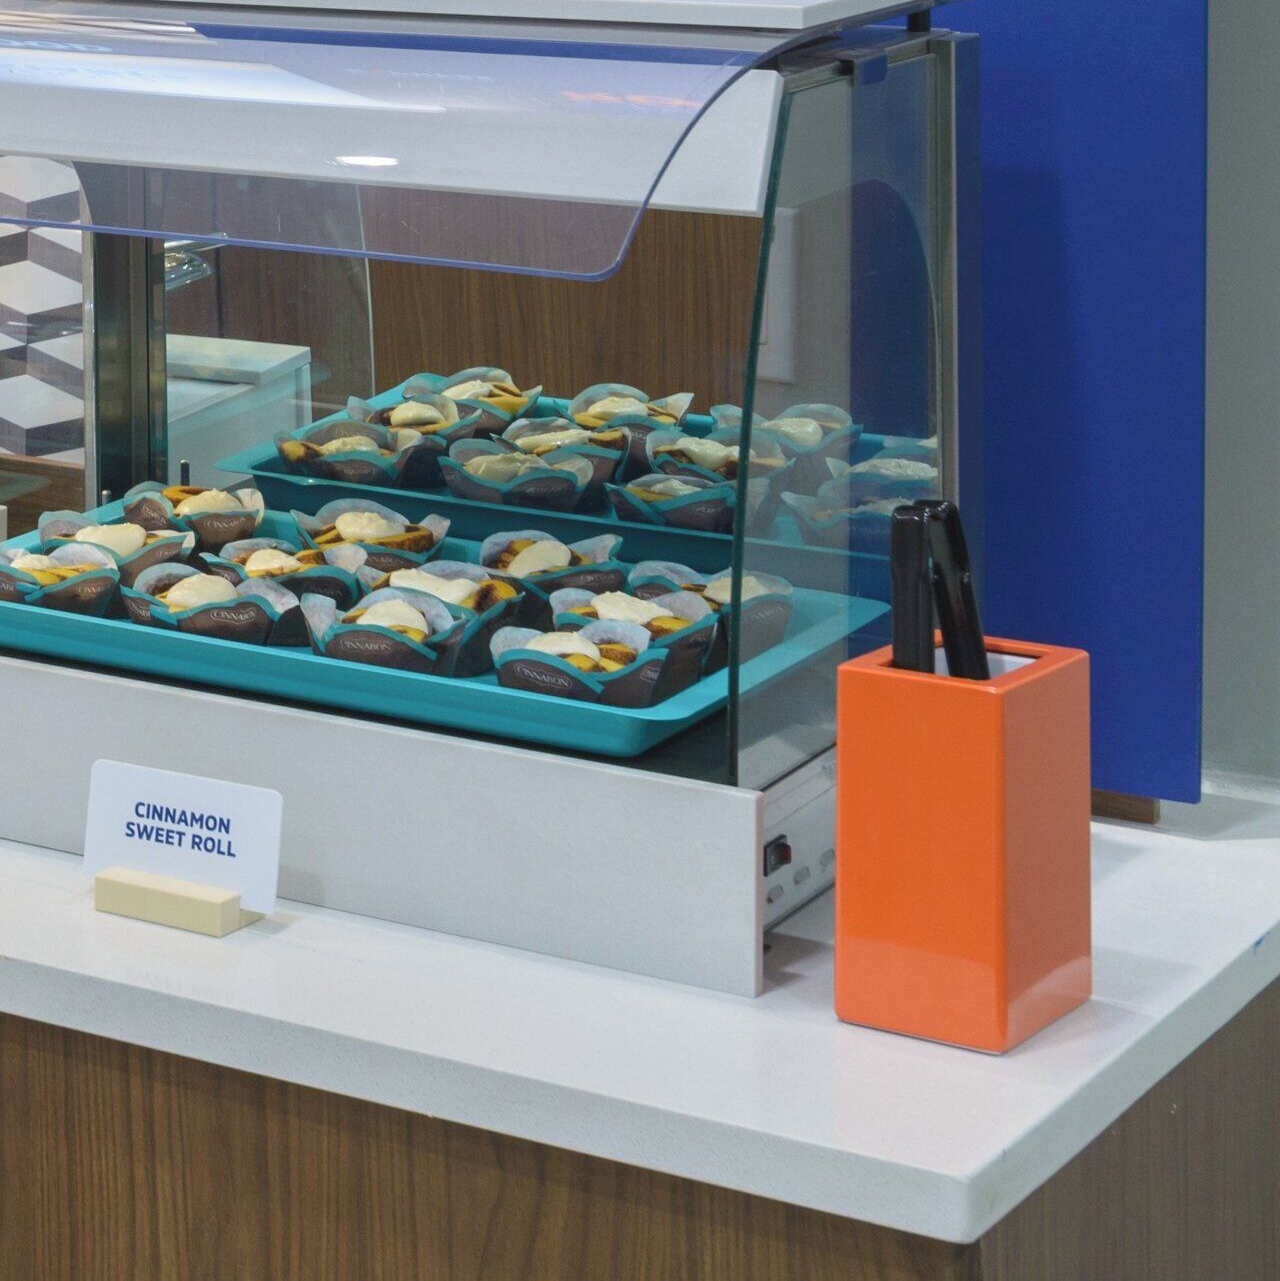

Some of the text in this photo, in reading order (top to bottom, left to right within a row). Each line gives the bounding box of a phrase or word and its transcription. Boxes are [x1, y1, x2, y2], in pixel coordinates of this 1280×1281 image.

[135, 801, 231, 835] CINNAMON
[125, 821, 236, 857] SWEET ROLL
